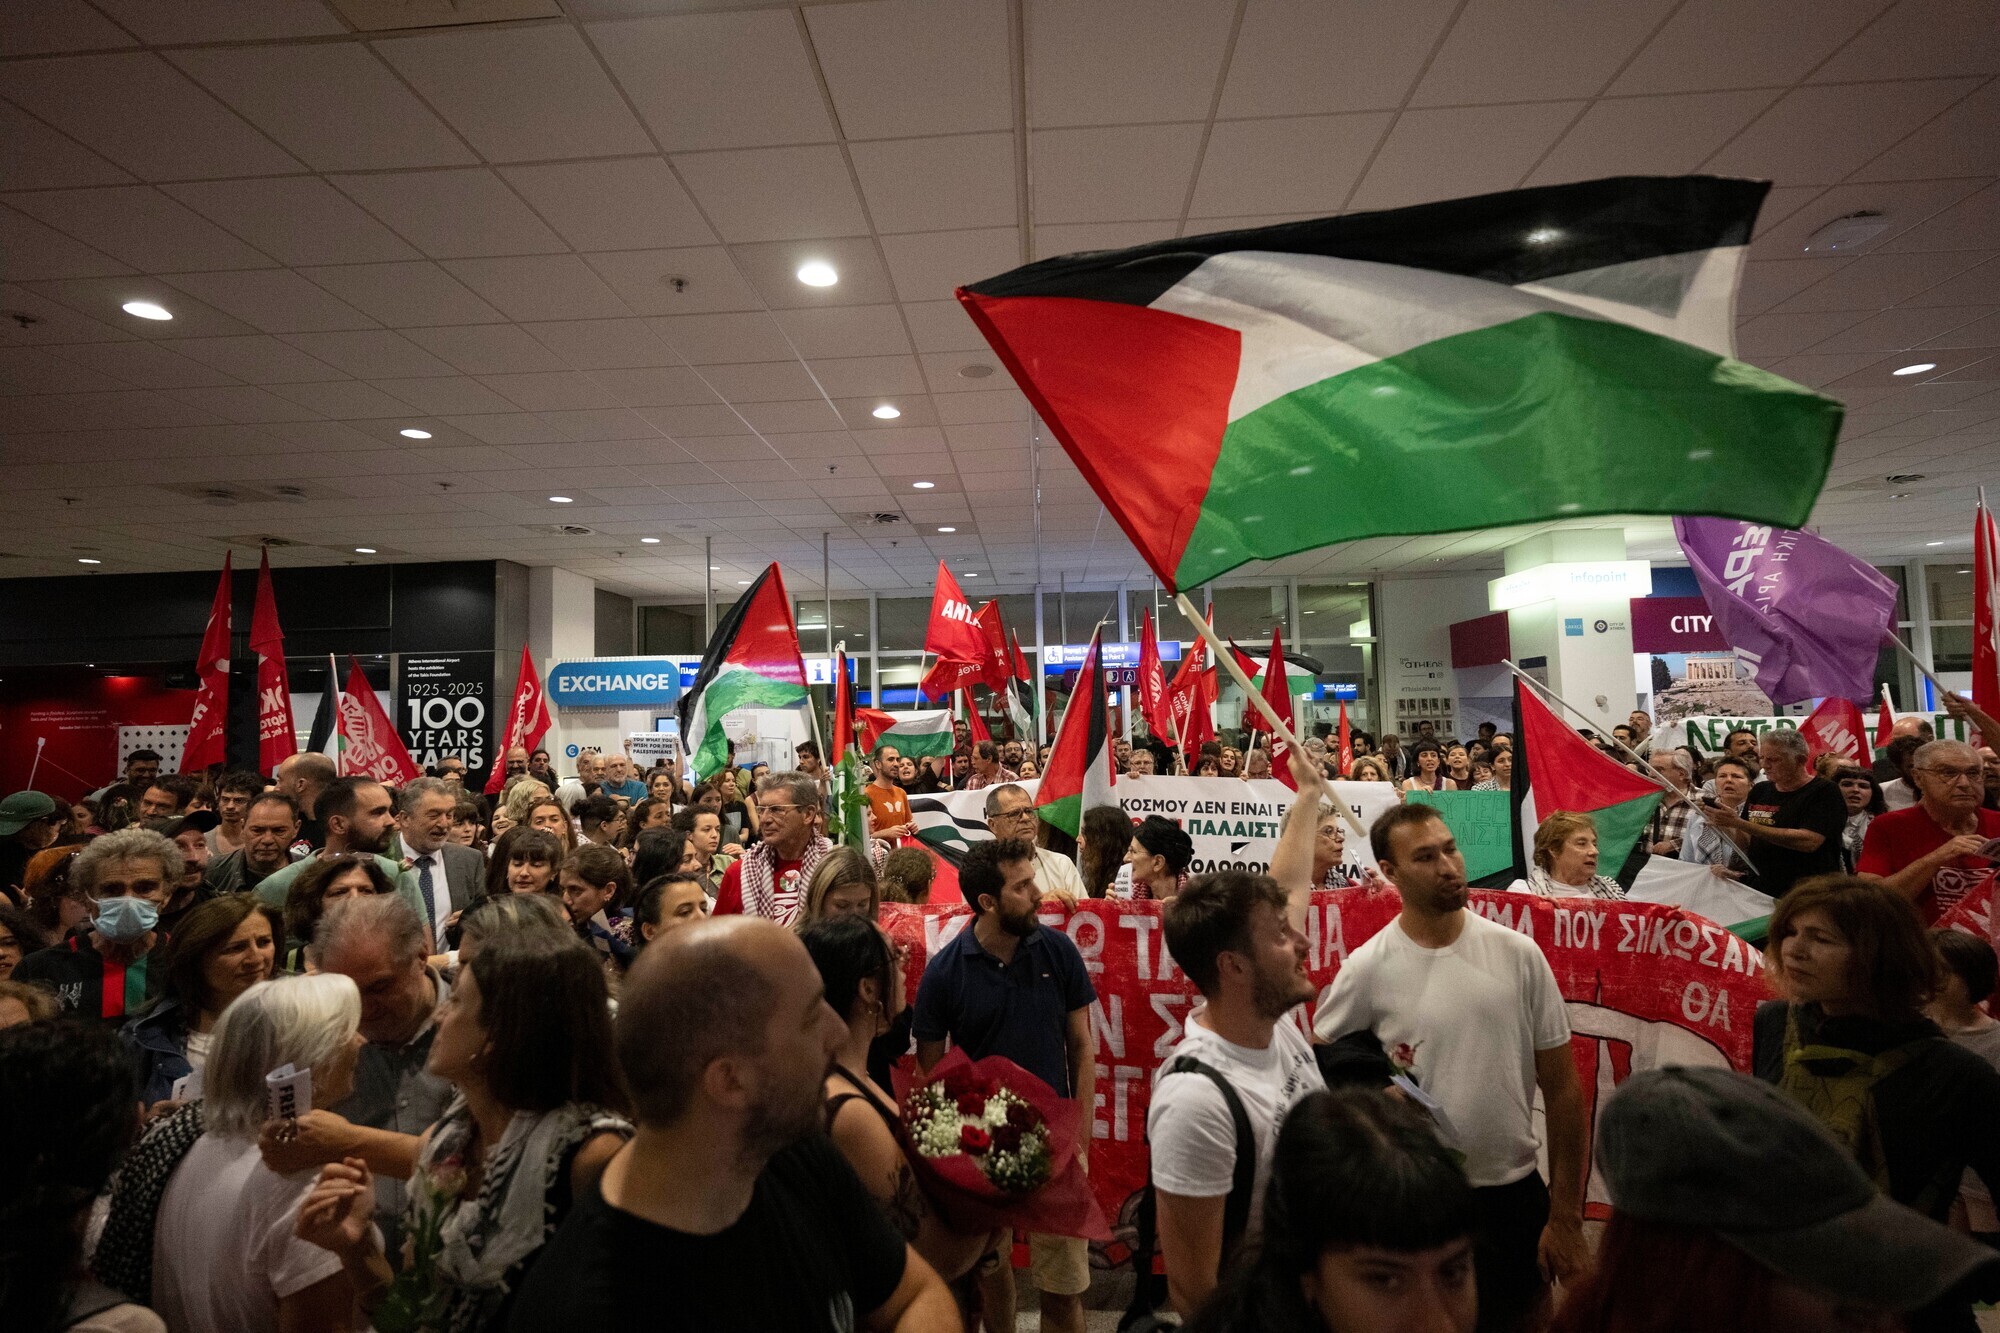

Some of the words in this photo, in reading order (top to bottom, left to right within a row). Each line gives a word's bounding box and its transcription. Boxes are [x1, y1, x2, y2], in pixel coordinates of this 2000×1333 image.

[1570, 571, 1628, 585] infopoint
[1670, 615, 1713, 633] CITY
[559, 673, 669, 693] EXCHANGE
[408, 696, 485, 729] 100
[408, 729, 484, 748] YEARS
[1120, 798, 1188, 813] ΚΟΣΜΟΥ
[1193, 801, 1225, 815] ΔΕΝ
[1231, 802, 1272, 817] ΕΙΝΑΙ
[1189, 819, 1280, 839] ΠΑΛΑΙΣΤ
[1554, 908, 1607, 950] ΠΟΥ
[1681, 981, 1731, 1032] ΘΑ
